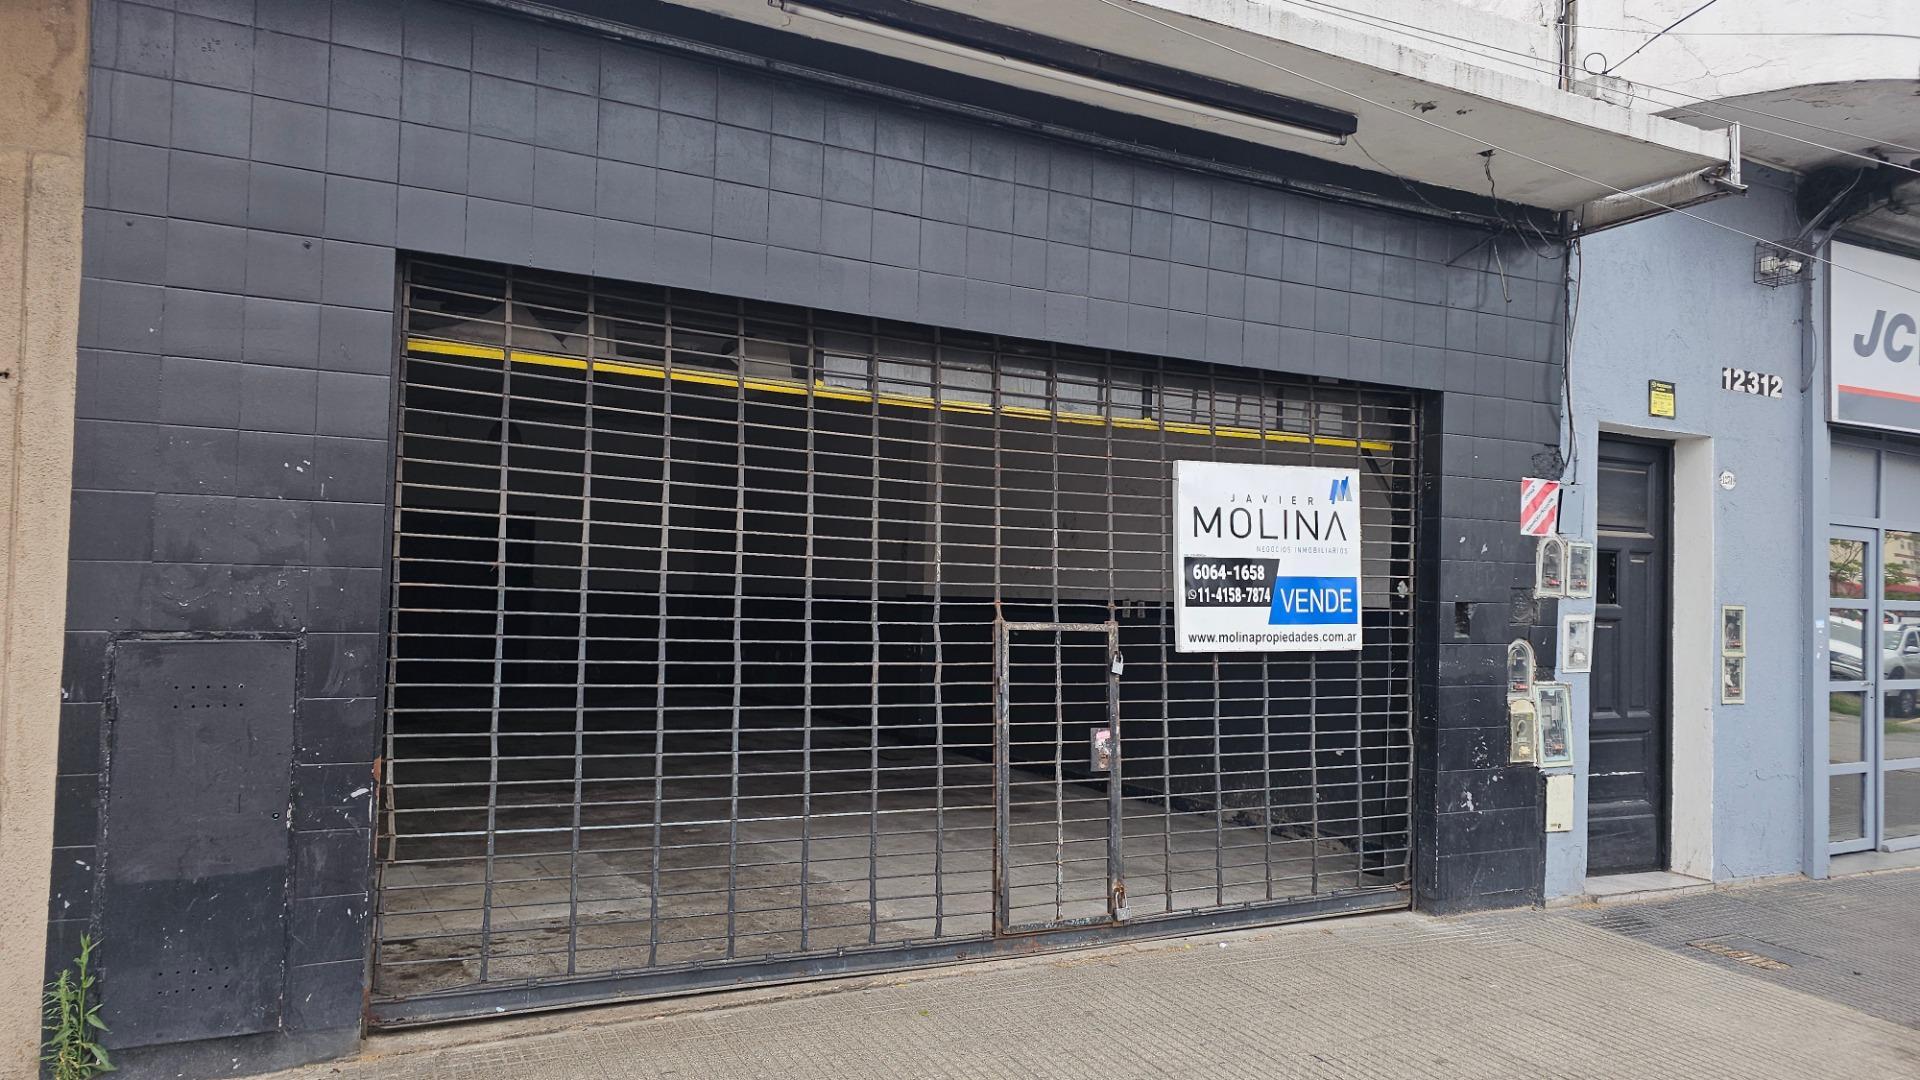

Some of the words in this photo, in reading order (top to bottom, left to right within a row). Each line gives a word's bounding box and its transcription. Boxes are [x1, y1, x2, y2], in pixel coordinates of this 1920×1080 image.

[1853, 309, 1920, 365] JC
[1723, 367, 1783, 399] 12312
[1230, 493, 1314, 506] JAVIER
[1192, 505, 1347, 541] MOLINA
[1256, 545, 1291, 554] NEGOCIOS
[1294, 546, 1349, 555] INMOBILIARIOS
[1192, 563, 1265, 581] 6064-1658
[1197, 586, 1271, 603] 11-4158-7874
[1280, 588, 1353, 614] VENDE
[1188, 630, 1357, 645] www.molinapropiedades.com.ar
